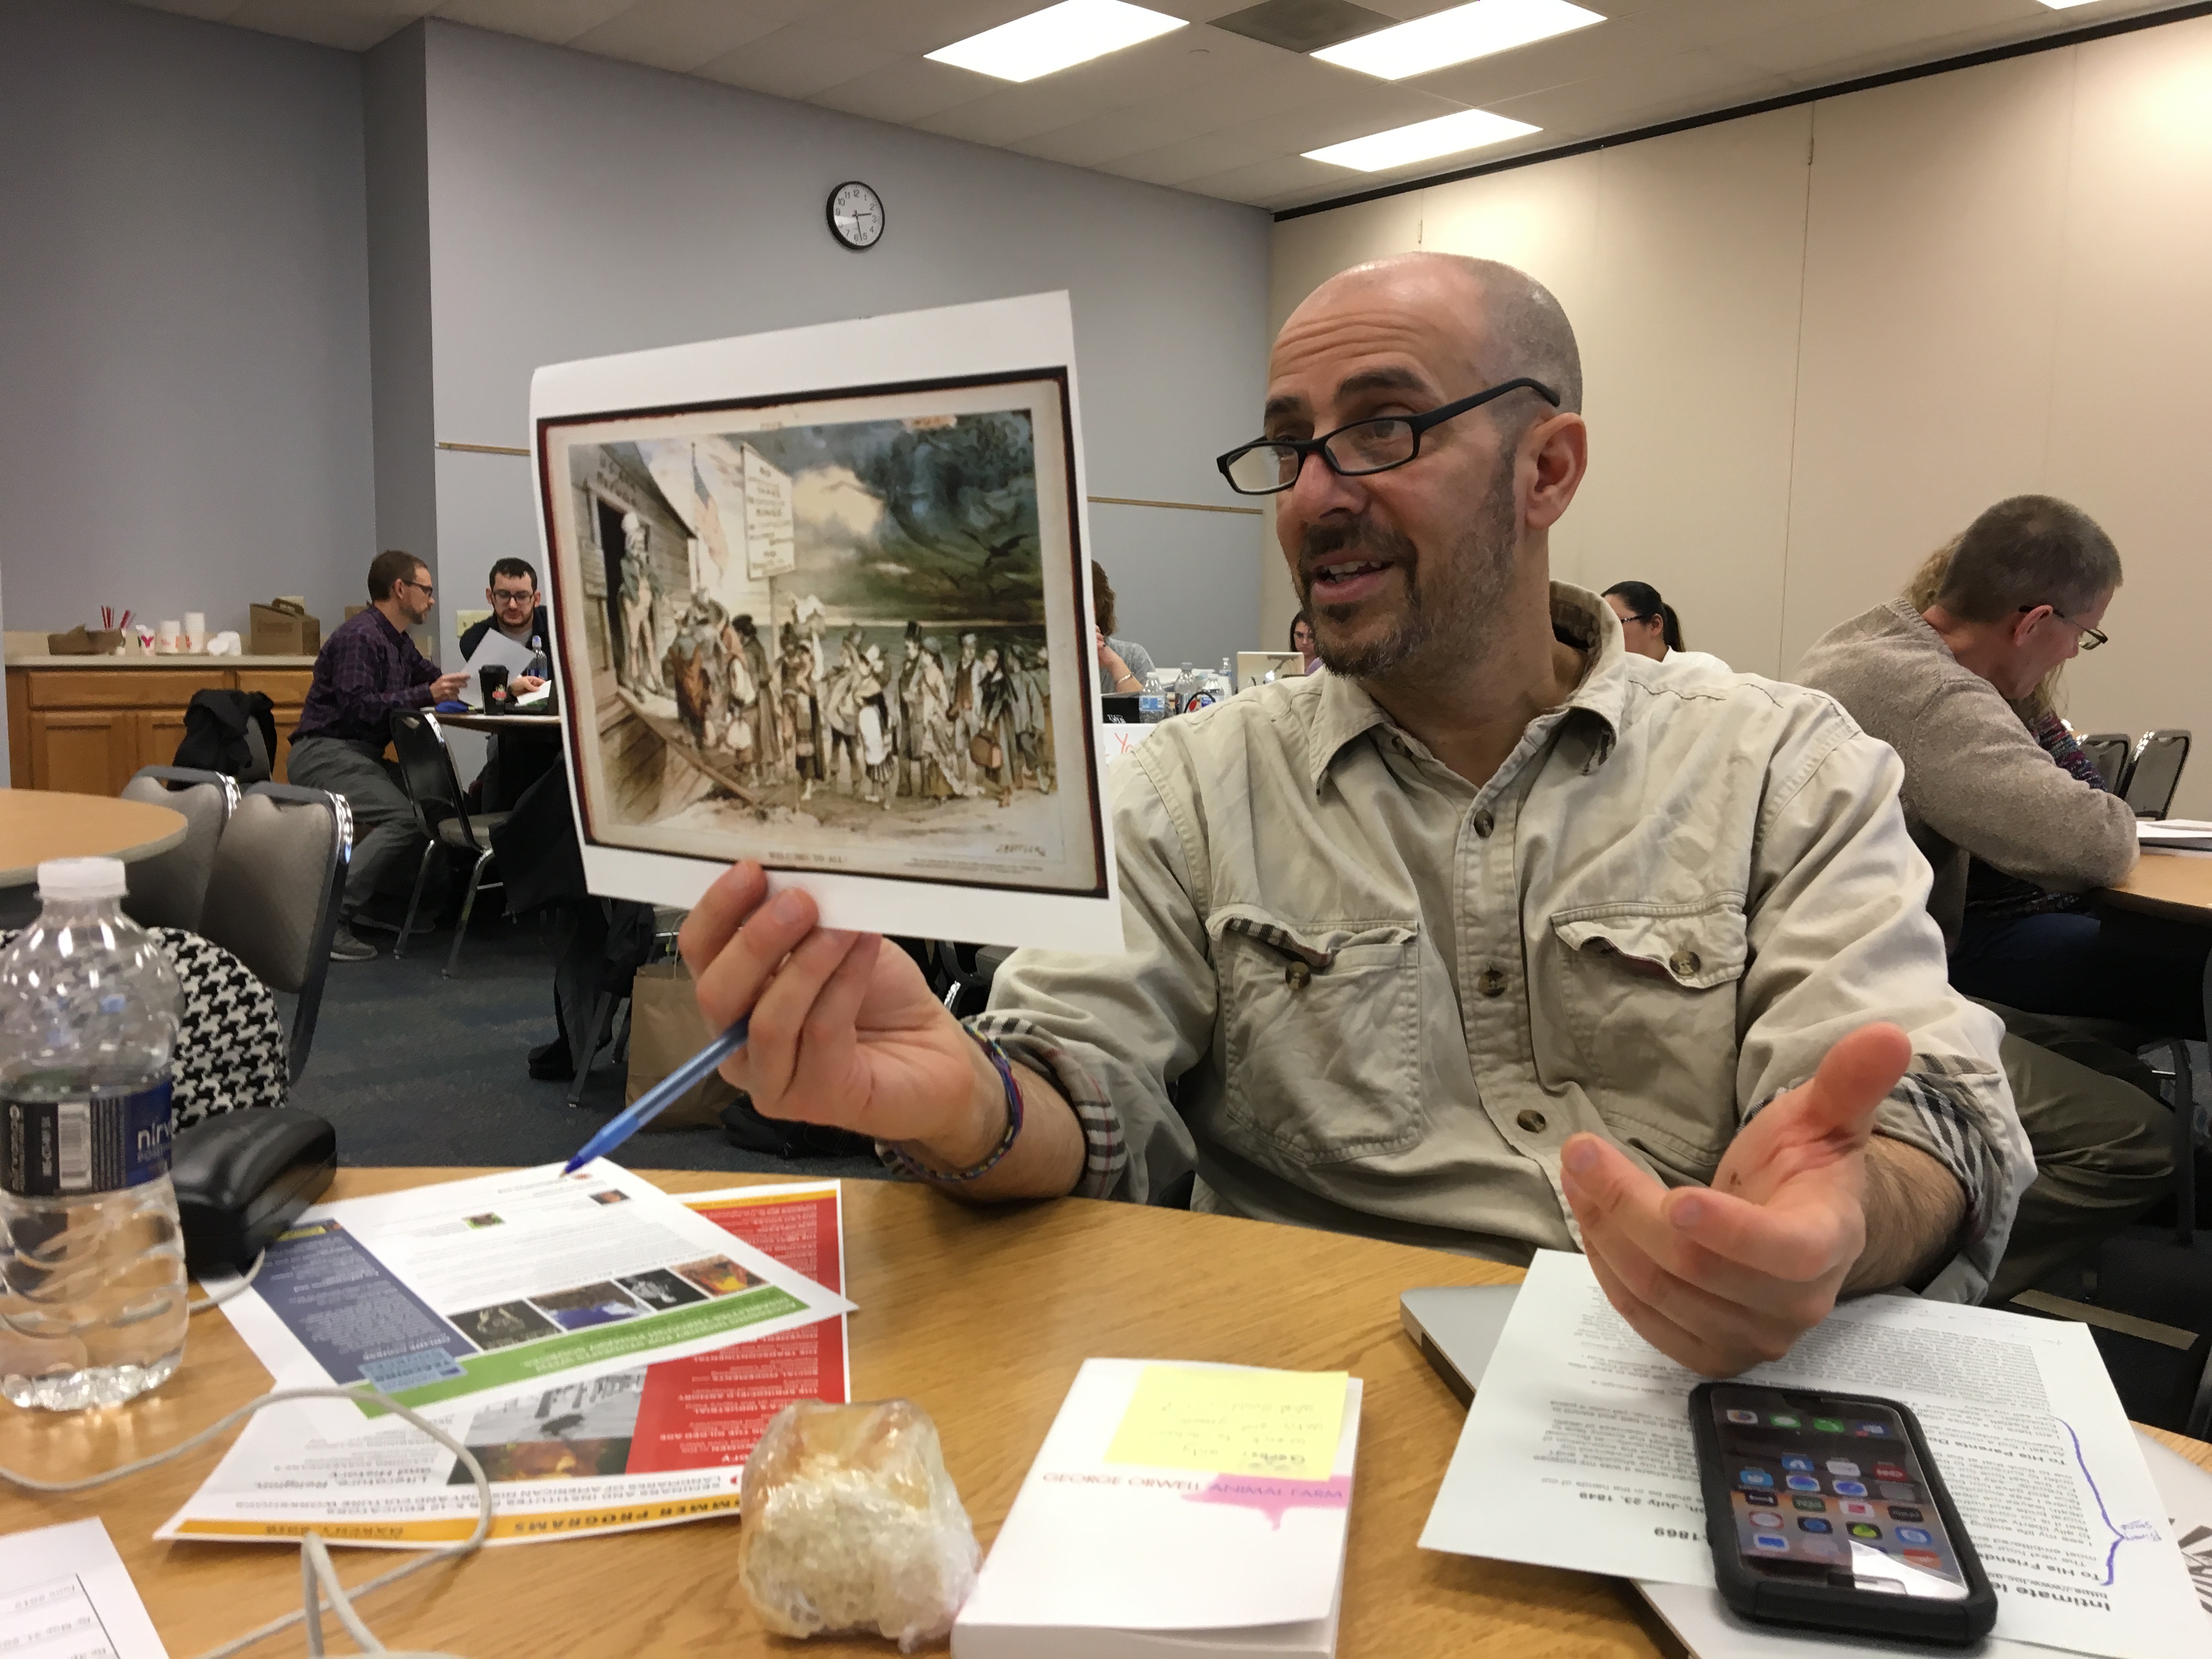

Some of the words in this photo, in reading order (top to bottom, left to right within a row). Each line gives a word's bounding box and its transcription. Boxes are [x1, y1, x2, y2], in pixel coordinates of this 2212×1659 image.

[838, 198, 845, 206] 10
[1953, 1440, 2013, 1457] Parents
[2017, 1452, 2044, 1462] His
[2047, 1457, 2067, 1466] To
[1042, 1471, 1121, 1485] GEORGE
[1128, 1475, 1199, 1491] ORWELL
[1209, 1483, 1282, 1497] ANIMAL
[1291, 1487, 1343, 1498] FARM
[1647, 1498, 1679, 1511] July
[515, 1509, 648, 1533] PROGRAMS
[1969, 1519, 2013, 1532] ending
[2015, 1528, 2035, 1536] life
[2038, 1531, 2057, 1540] my
[2061, 1536, 2084, 1544] see
[1997, 1546, 2027, 1556] hour
[2065, 1550, 2097, 1561] most
[2029, 1552, 2057, 1562] next
[2061, 1558, 2085, 1567] The
[2045, 1565, 2075, 1576] His
[2079, 1570, 2103, 1581] To
[2013, 1586, 2112, 1611] Intimate
